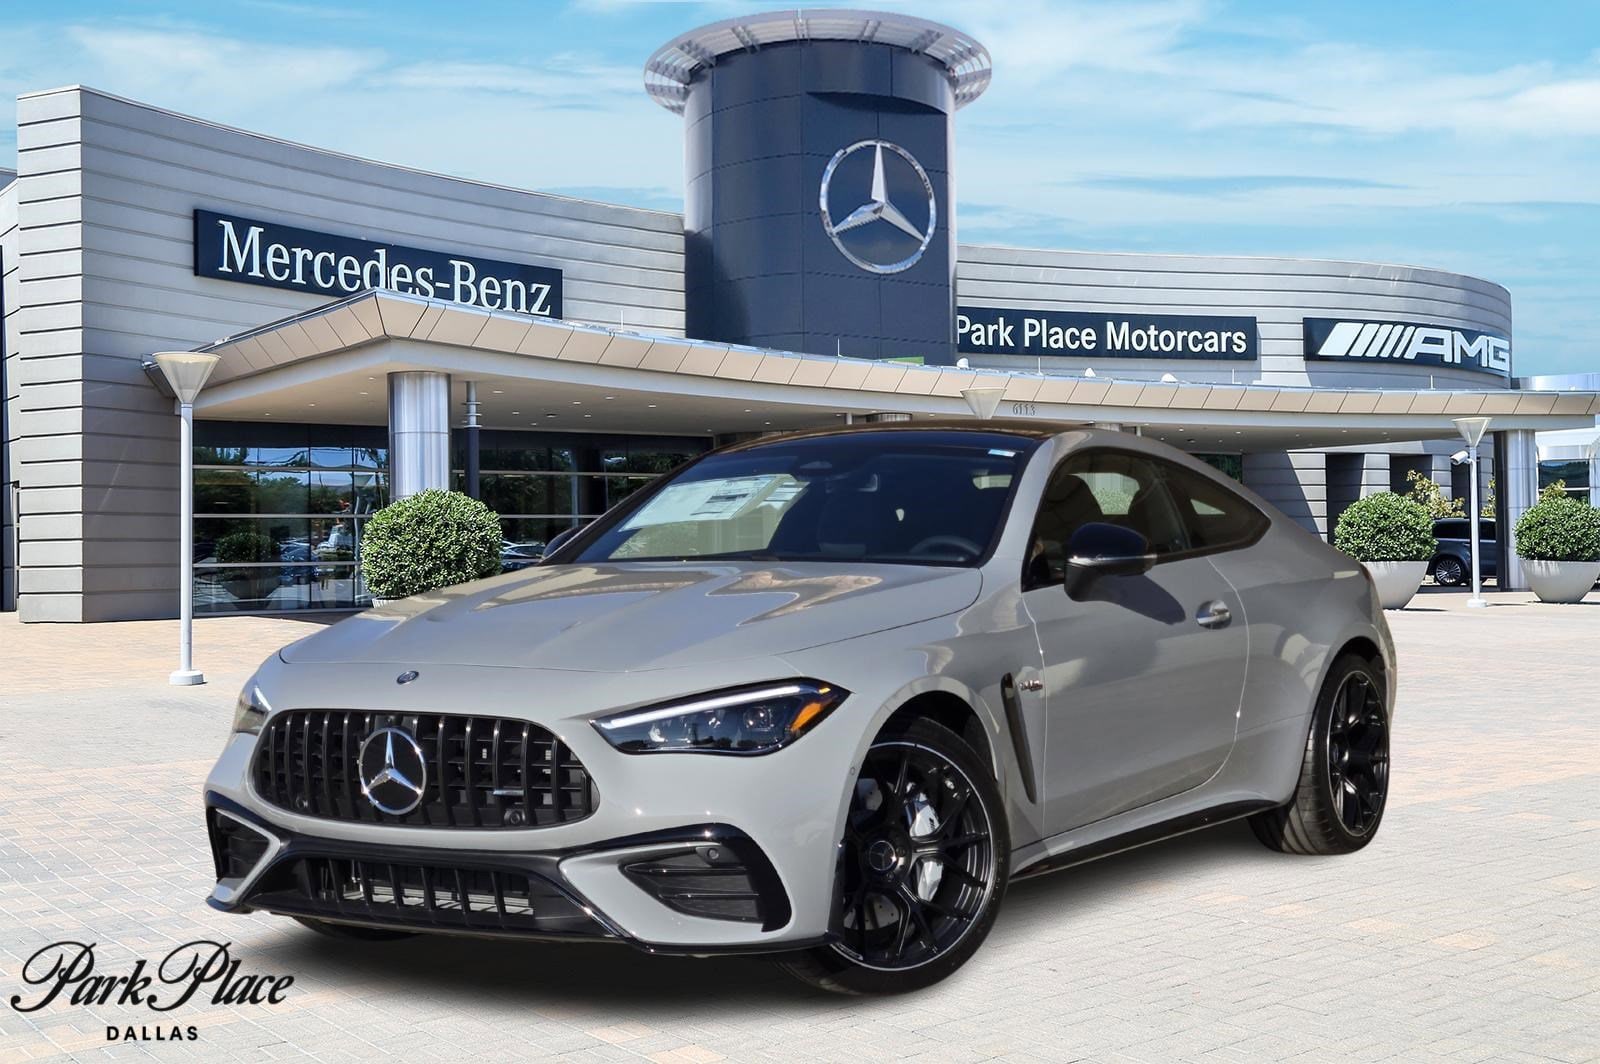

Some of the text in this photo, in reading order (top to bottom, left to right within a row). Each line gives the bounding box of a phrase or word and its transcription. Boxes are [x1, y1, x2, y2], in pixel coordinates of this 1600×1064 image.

[217, 219, 552, 316] Mercedes-Benz
[957, 314, 1248, 353] Park Place Motorcars
[1012, 402, 1036, 416] 6113
